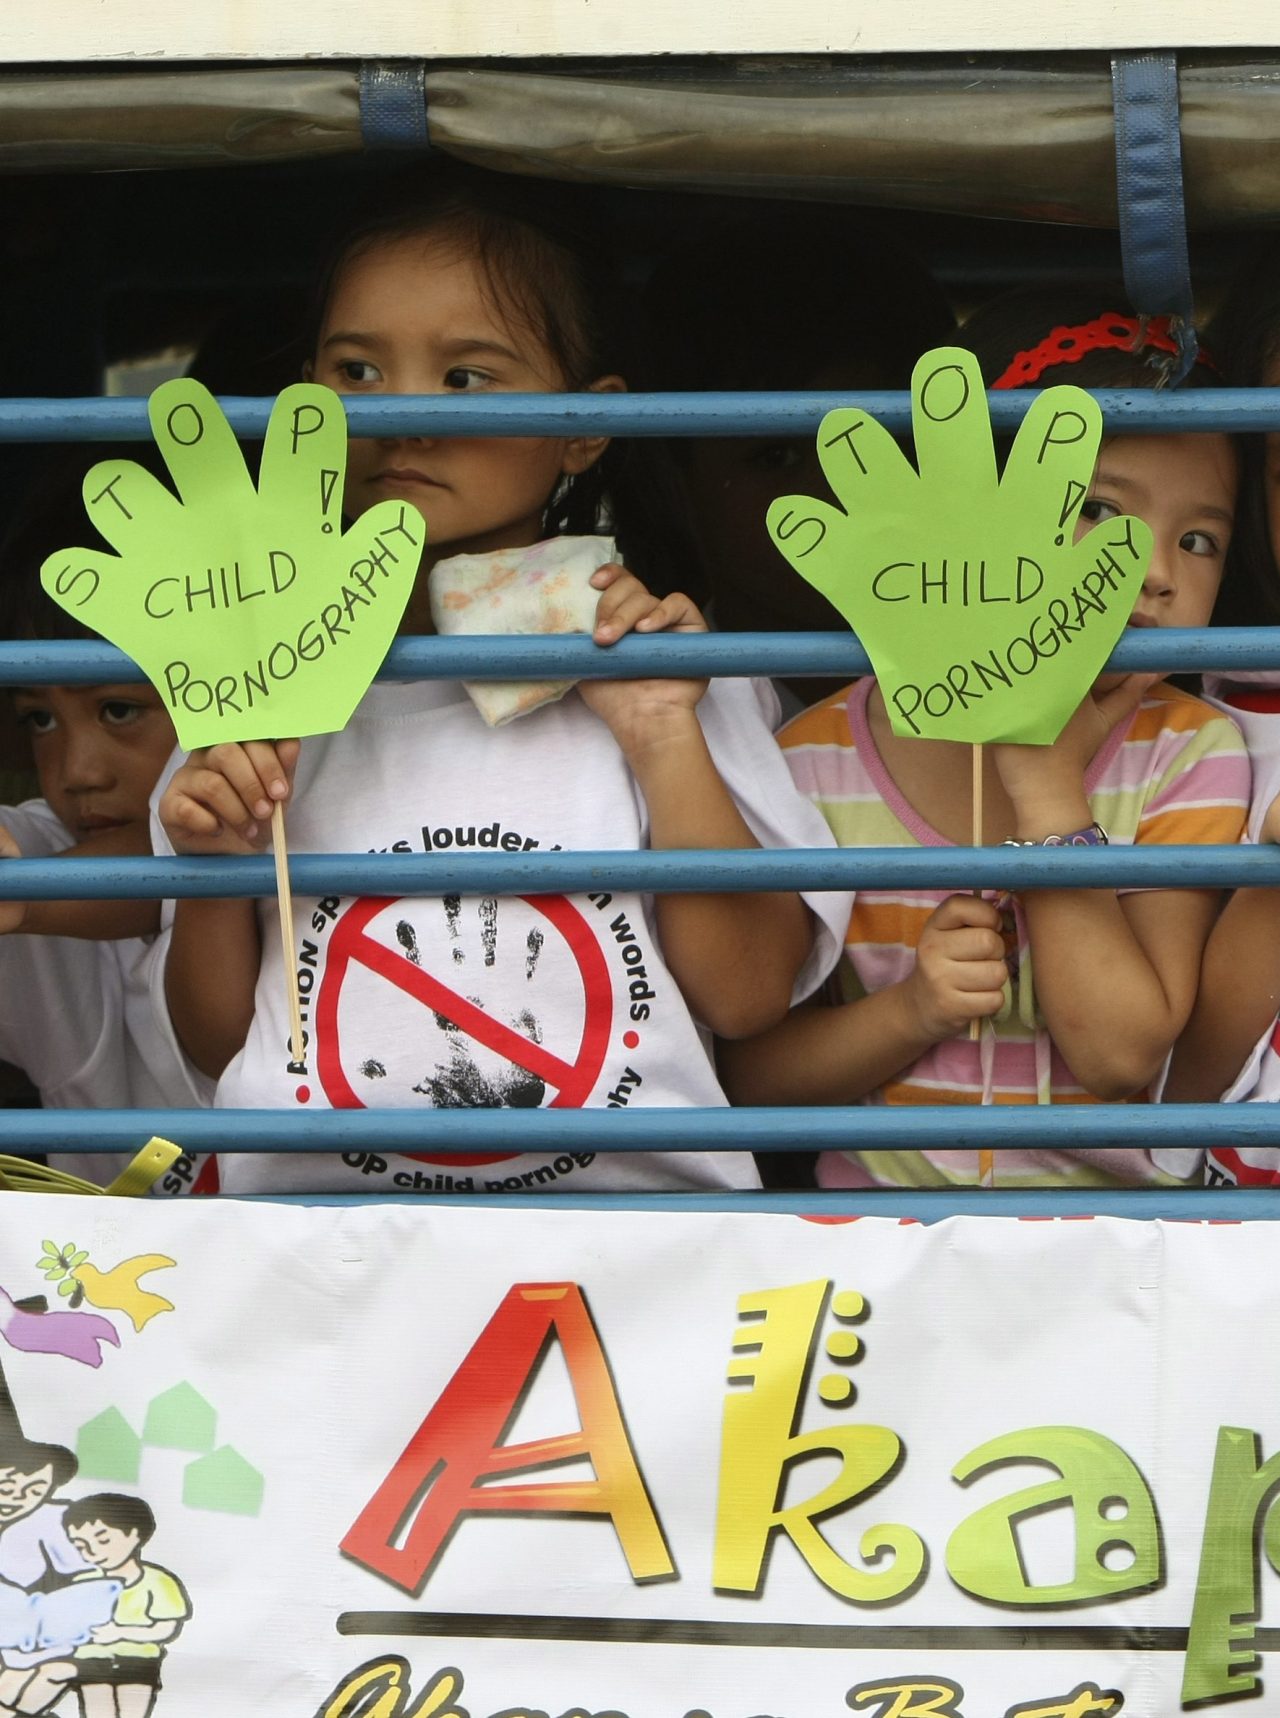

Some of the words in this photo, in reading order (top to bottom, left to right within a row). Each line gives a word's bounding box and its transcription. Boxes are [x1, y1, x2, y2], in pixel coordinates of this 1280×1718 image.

[144, 551, 297, 619] CHILD
[164, 507, 418, 717] PORNOGRAPHY
[872, 556, 1044, 607] CHILD
[892, 519, 1140, 735] PORNOGRAPHY
[421, 822, 540, 851] louder
[609, 912, 657, 1022] words
[392, 1171, 475, 1192] child
